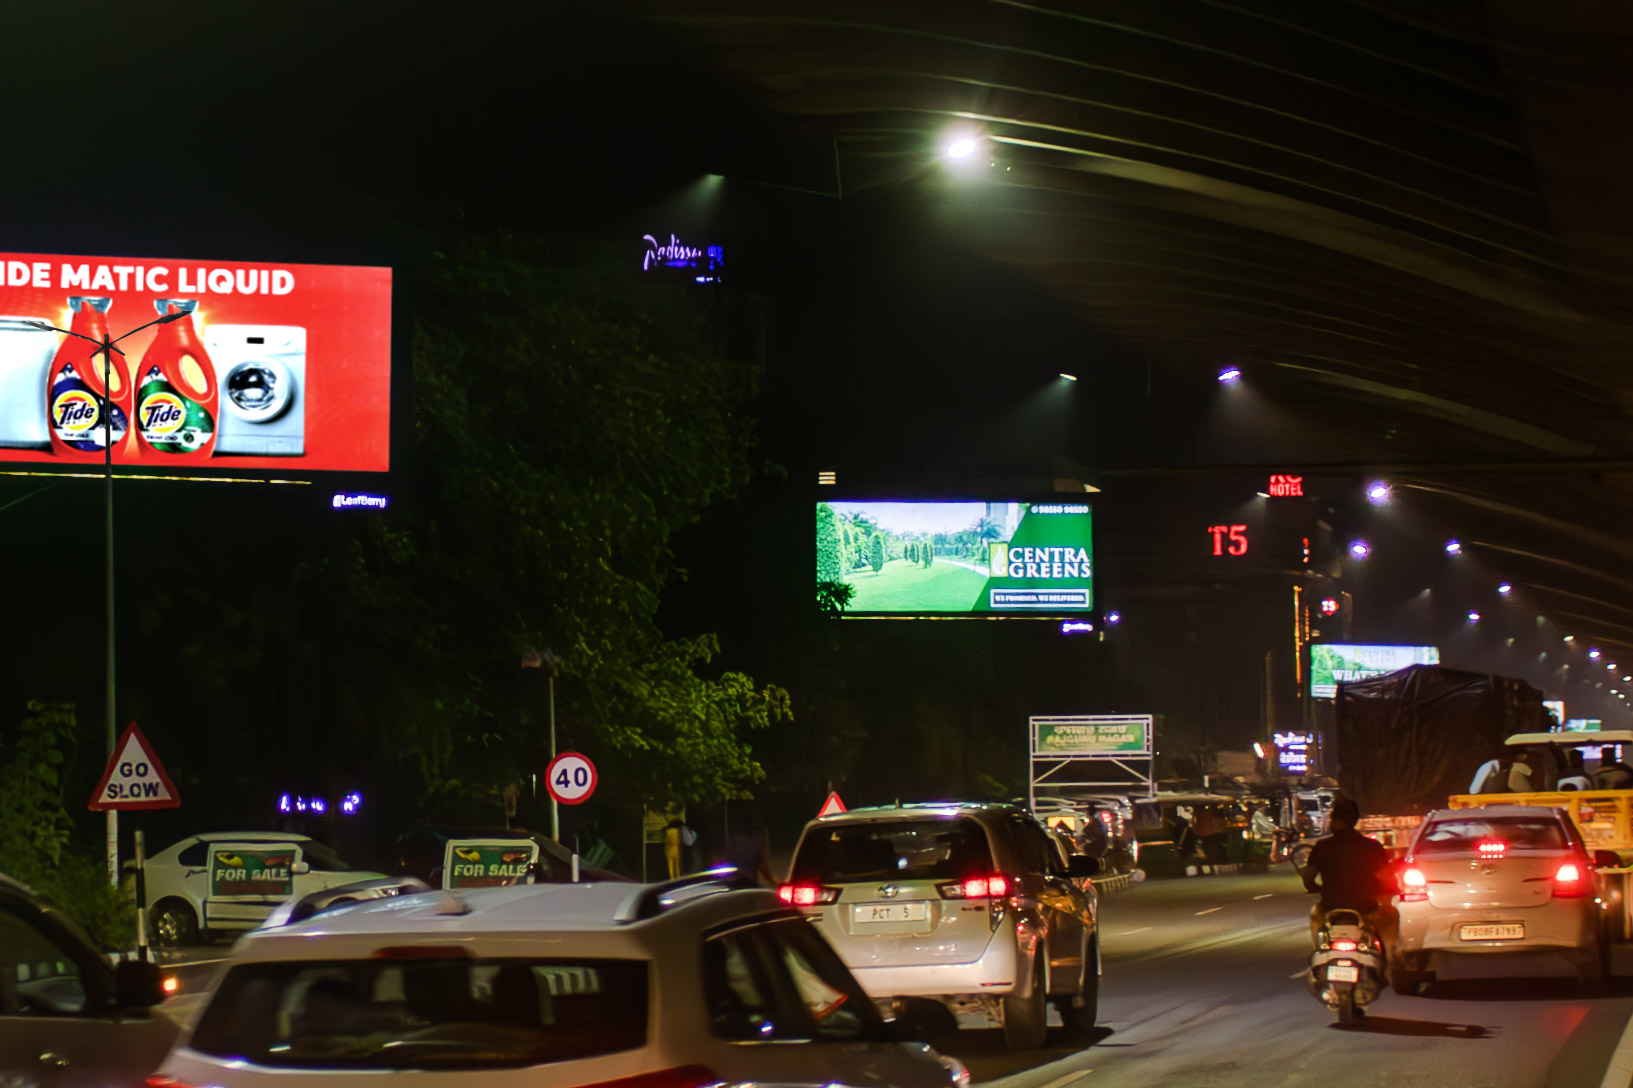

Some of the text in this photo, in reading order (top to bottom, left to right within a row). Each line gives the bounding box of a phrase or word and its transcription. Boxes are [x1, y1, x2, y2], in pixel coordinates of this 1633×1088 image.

[60, 264, 169, 292] MATIC
[178, 268, 295, 295] LIQUID
[58, 402, 96, 425] Tide
[145, 404, 182, 428] Tide
[1270, 483, 1303, 496] HOTEL
[1208, 524, 1248, 555] T5
[1008, 547, 1090, 563] CENTRA
[1008, 562, 1091, 578] GREENS
[119, 762, 148, 778] GO
[555, 767, 588, 788] 40
[107, 781, 160, 799] SLOW
[216, 868, 289, 881] FOR SALE
[454, 864, 527, 877] FOR SALE
